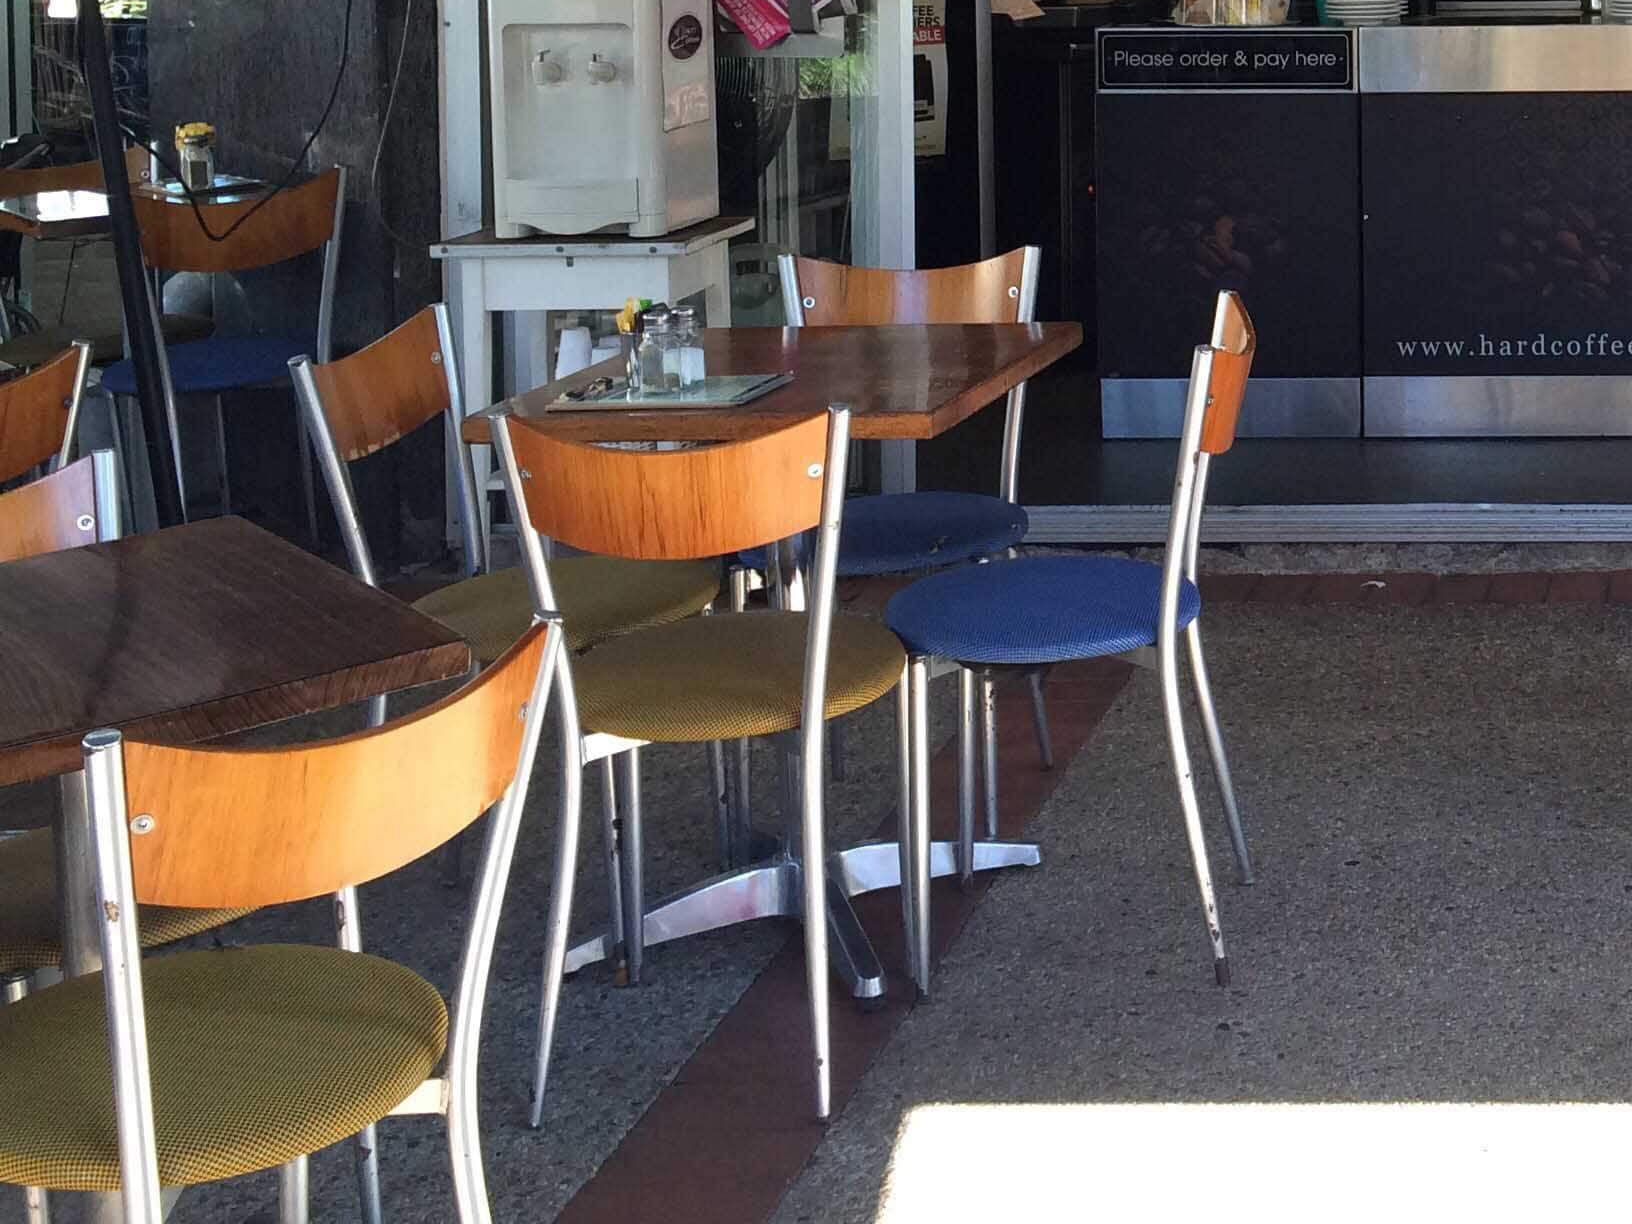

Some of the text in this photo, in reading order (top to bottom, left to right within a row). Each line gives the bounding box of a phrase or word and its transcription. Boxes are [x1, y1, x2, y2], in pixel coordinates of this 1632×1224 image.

[1113, 50, 1337, 69] Please order & pay here
